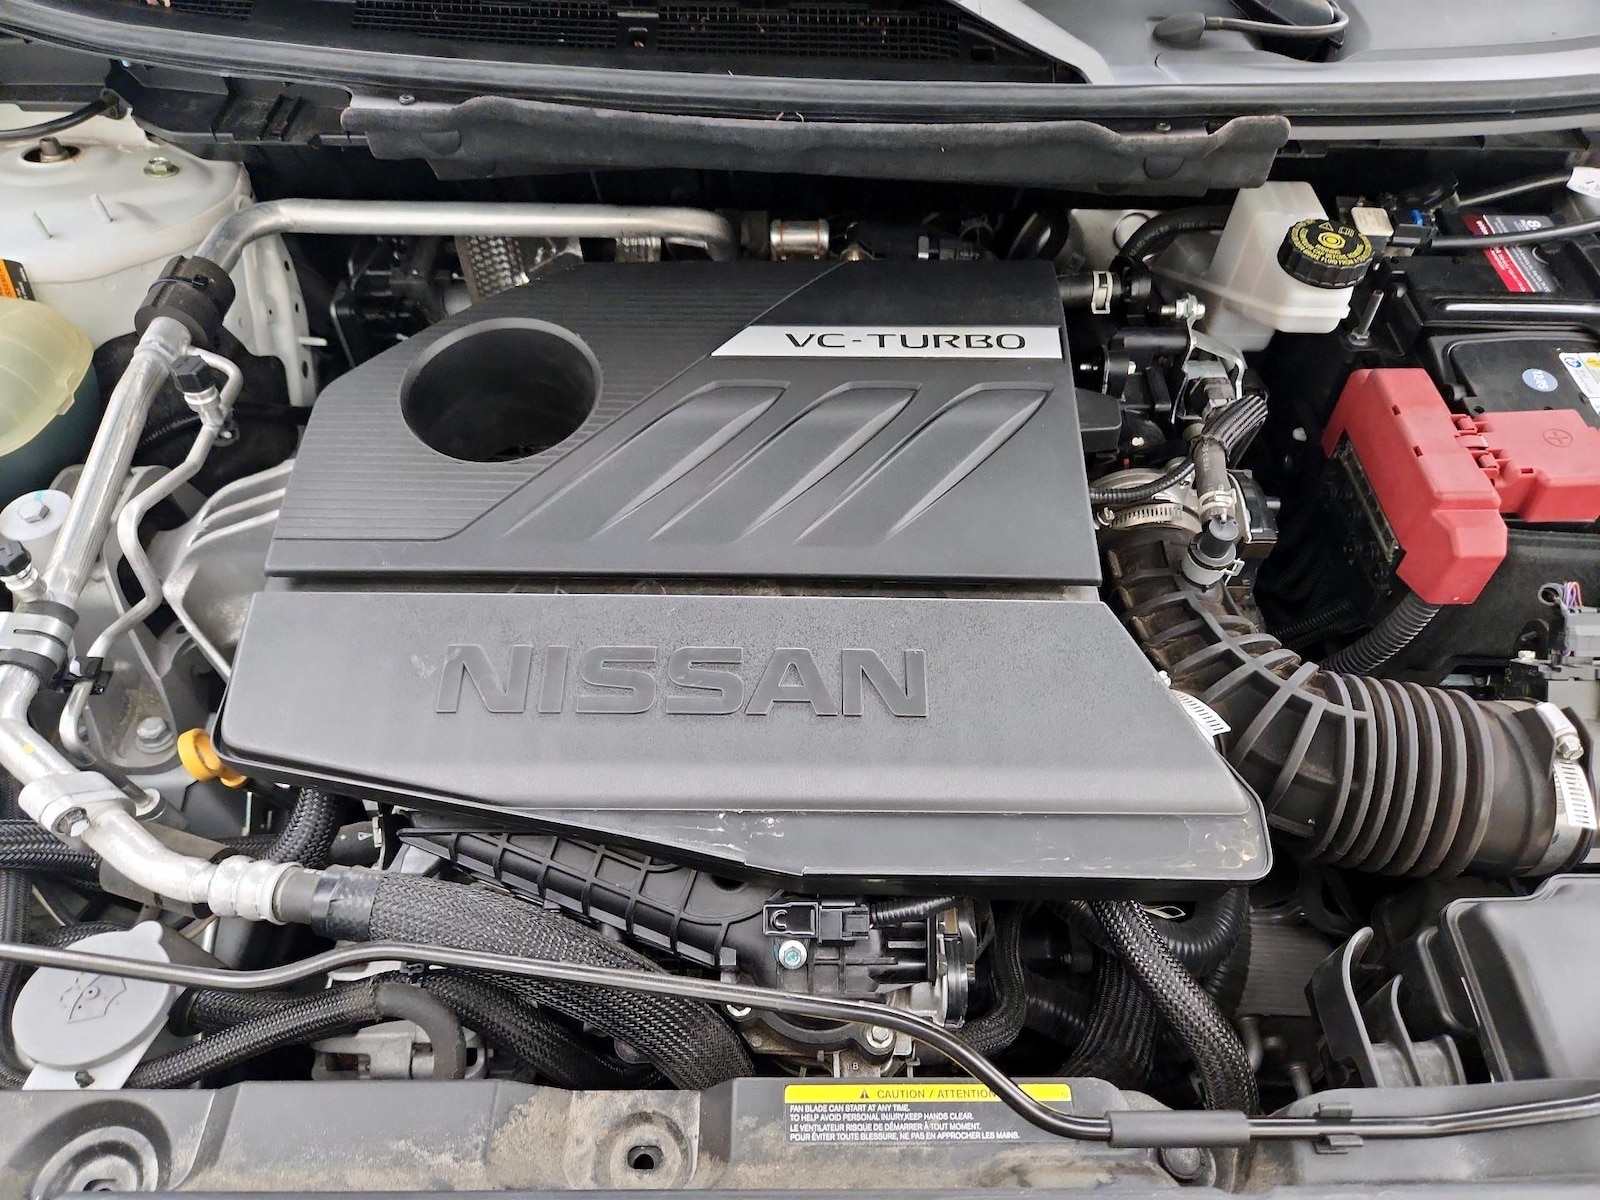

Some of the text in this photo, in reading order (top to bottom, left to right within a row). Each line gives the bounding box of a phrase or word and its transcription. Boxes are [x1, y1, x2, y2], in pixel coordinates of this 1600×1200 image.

[785, 333, 1026, 350] VC-TURBO
[436, 644, 927, 717] NISSAN
[877, 1089, 925, 1099] CAUTION
[929, 1089, 934, 1099] /
[790, 1104, 910, 1113] FAN BLADE CAN START AT ANY TIME.
[790, 1113, 800, 1122] TO
[801, 1113, 819, 1121] HELP
[821, 1113, 841, 1121] AVOID
[843, 1113, 879, 1121] PERSONAL
[924, 1112, 948, 1120] HANDS
[950, 1112, 974, 1120] CLEAR.
[790, 1121, 981, 1132] LE VENTILATEUR RISQUE DE DÉMARRER À TOUT MOMENT.
[790, 1133, 810, 1141] POUR
[812, 1131, 836, 1141] ÉVITER
[837, 1132, 859, 1140] TOUTE
[860, 1132, 899, 1141] BLESSURE,
[900, 1132, 910, 1140] NE
[911, 1132, 925, 1140] PAS
[926, 1132, 936, 1140] EN
[937, 1132, 980, 1140] APPROCHER
